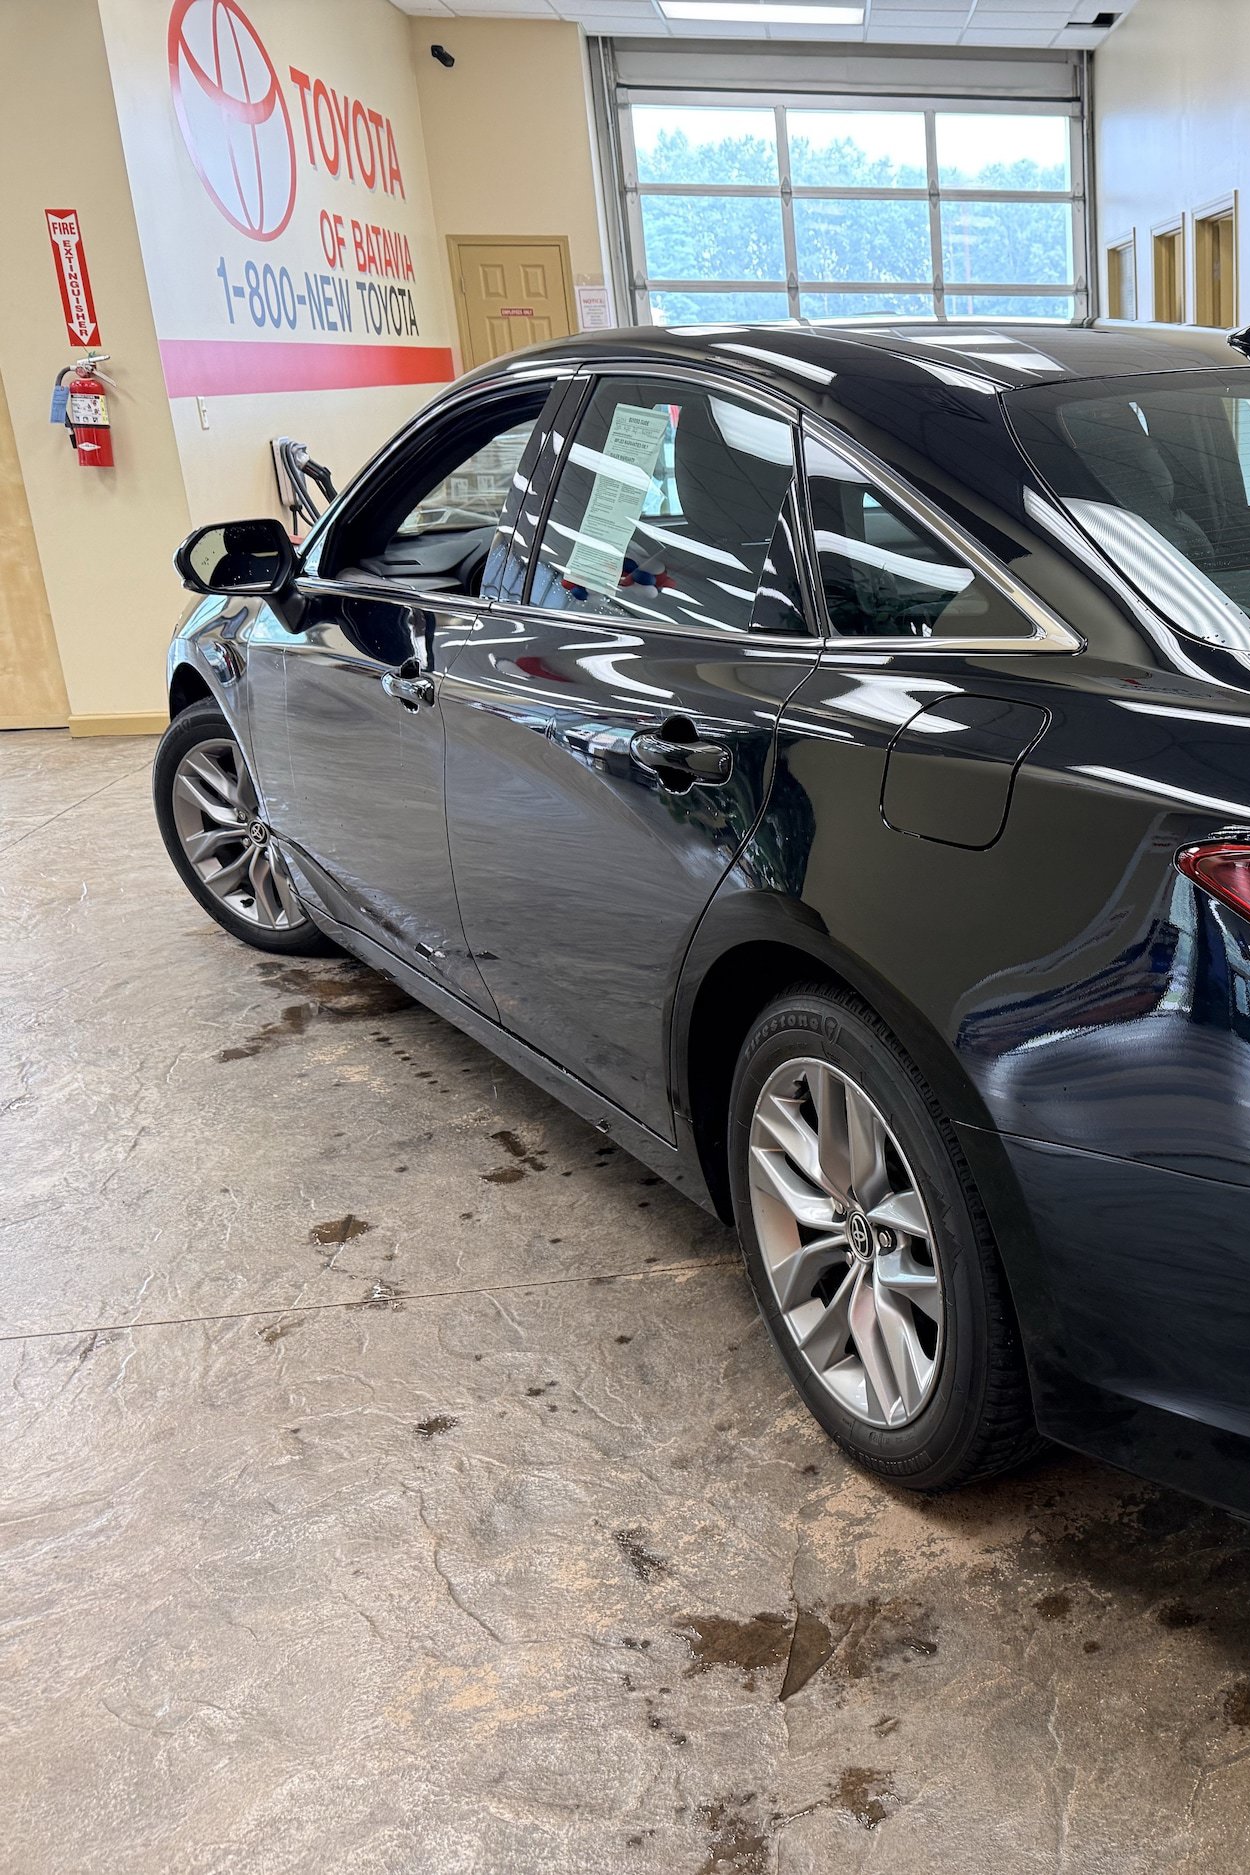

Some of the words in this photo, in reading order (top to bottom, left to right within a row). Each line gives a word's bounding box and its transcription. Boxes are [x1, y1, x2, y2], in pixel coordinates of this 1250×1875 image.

[289, 65, 406, 200] TOYOTA
[51, 222, 76, 235] FIRE
[319, 208, 346, 270] OF
[350, 219, 416, 283] BATAVIA
[62, 240, 89, 336] EXTINGUISHER
[216, 256, 352, 332] 1-800-NEW
[356, 281, 420, 337] TOYOTA
[744, 1014, 819, 1061] Firestone
